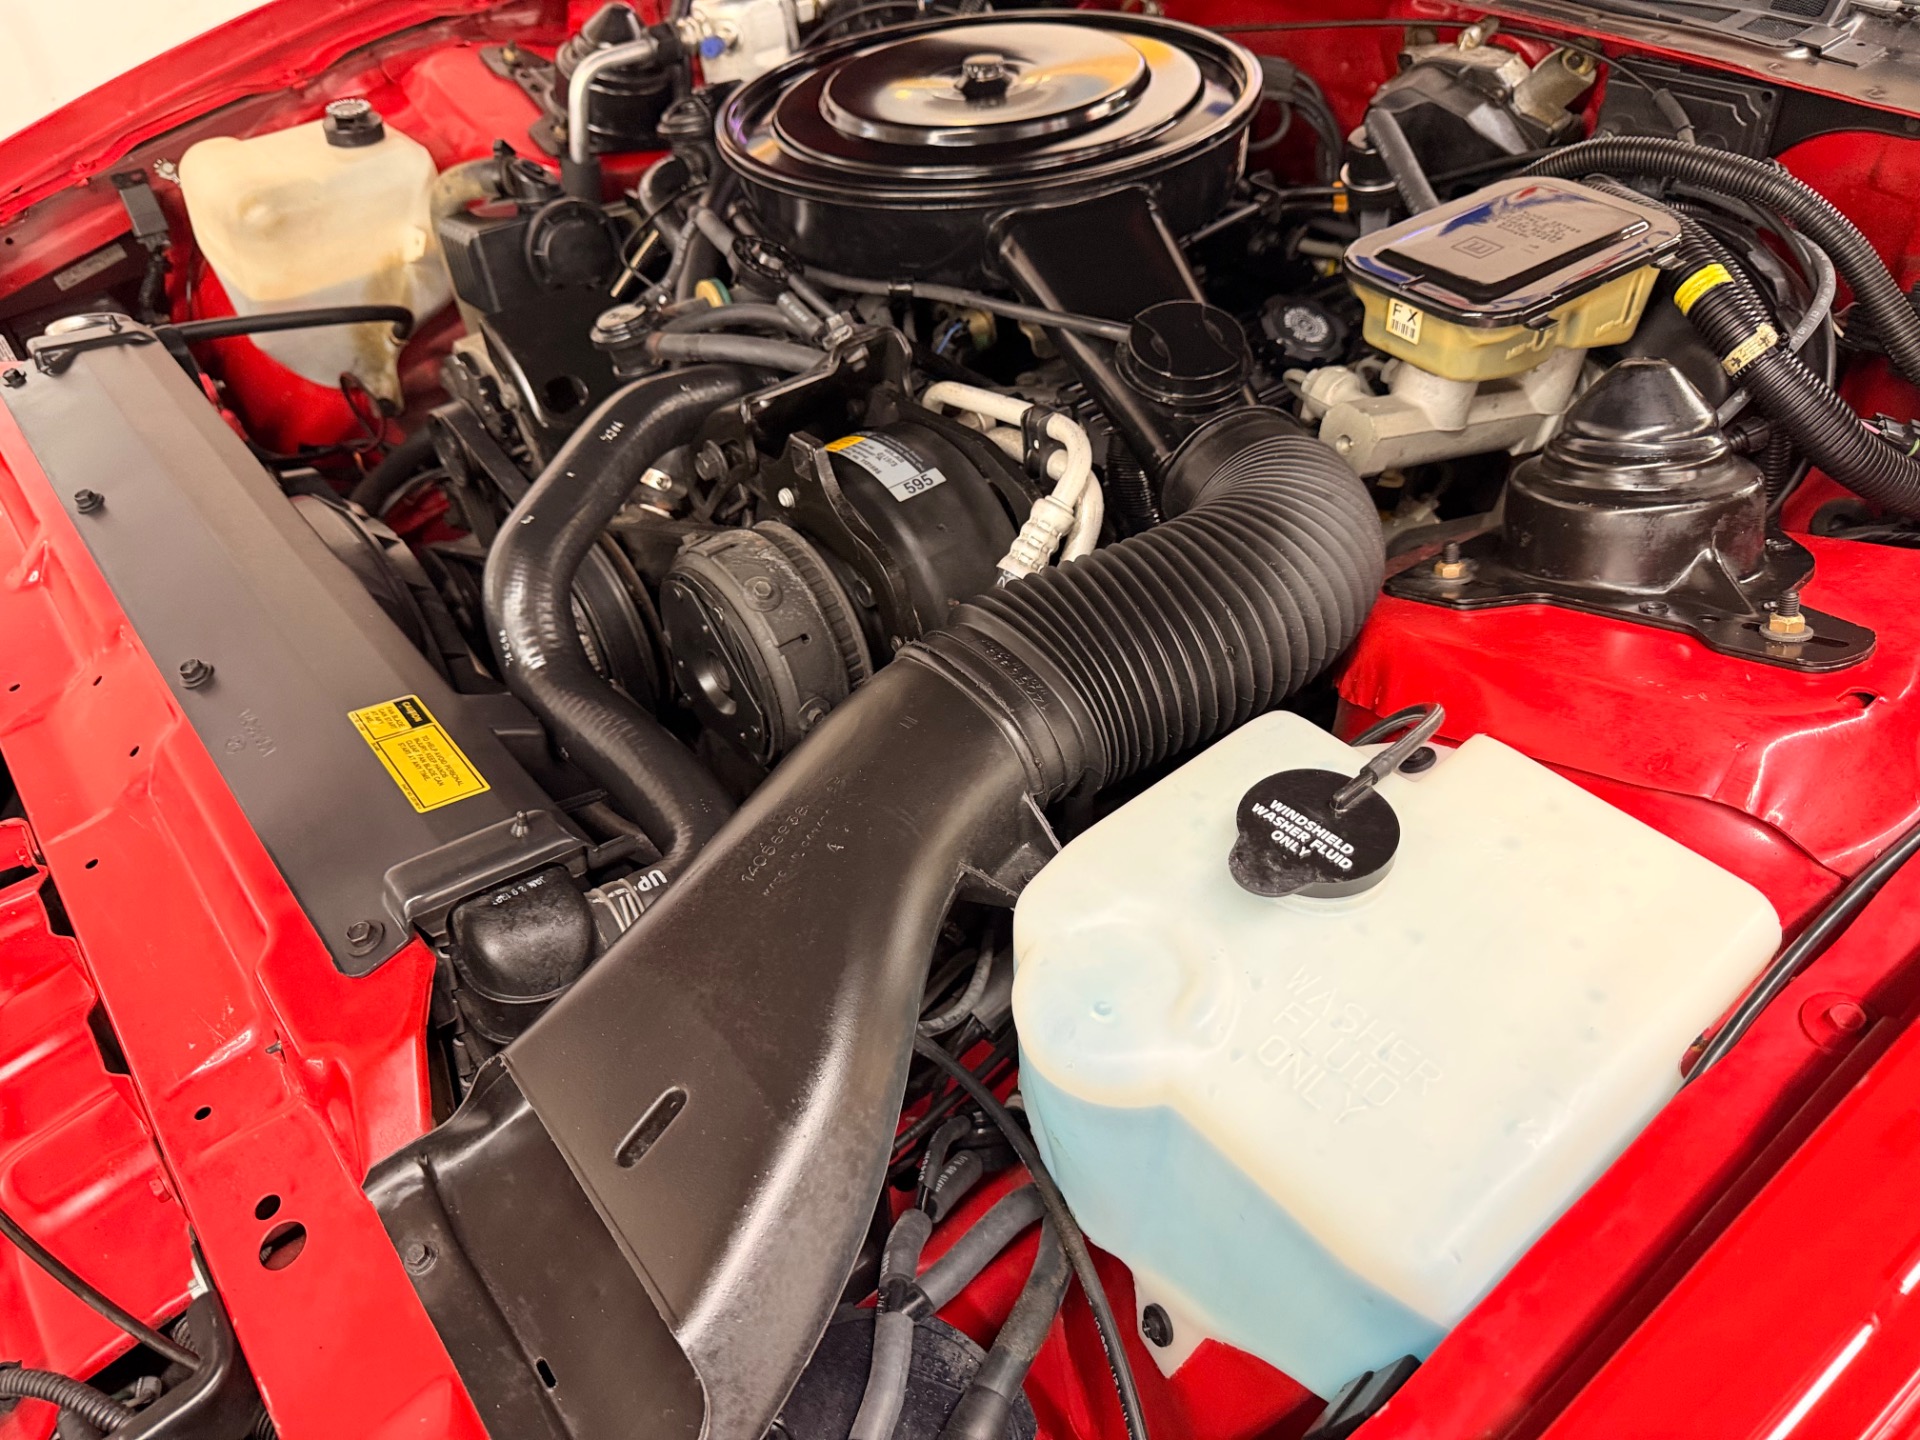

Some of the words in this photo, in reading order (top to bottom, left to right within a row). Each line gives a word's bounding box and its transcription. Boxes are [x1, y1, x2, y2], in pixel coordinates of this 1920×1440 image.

[903, 473, 934, 494] 595
[379, 708, 389, 718] CAN
[384, 716, 398, 729] START
[393, 714, 406, 728] BLADE
[401, 701, 423, 723] CAUTION
[398, 742, 411, 755] START
[412, 760, 422, 770] ANY
[418, 753, 427, 763] FAN
[423, 762, 437, 777] BLADE
[433, 776, 444, 787] CAN
[426, 741, 438, 752] HELP
[436, 751, 448, 765] AVOID
[444, 763, 464, 786] PERSONAL
[426, 753, 437, 764] KEEP
[434, 763, 449, 779] HANDS
[1251, 802, 1311, 843] WASHER
[1310, 838, 1354, 870] FLUID
[1269, 799, 1355, 856] WINDSHIELD
[1270, 829, 1312, 858] ONLY
[527, 875, 546, 889] JAN
[1285, 964, 1444, 1097] WASHER
[1272, 1002, 1400, 1106] FLUID
[1257, 1034, 1368, 1124] ONLY
